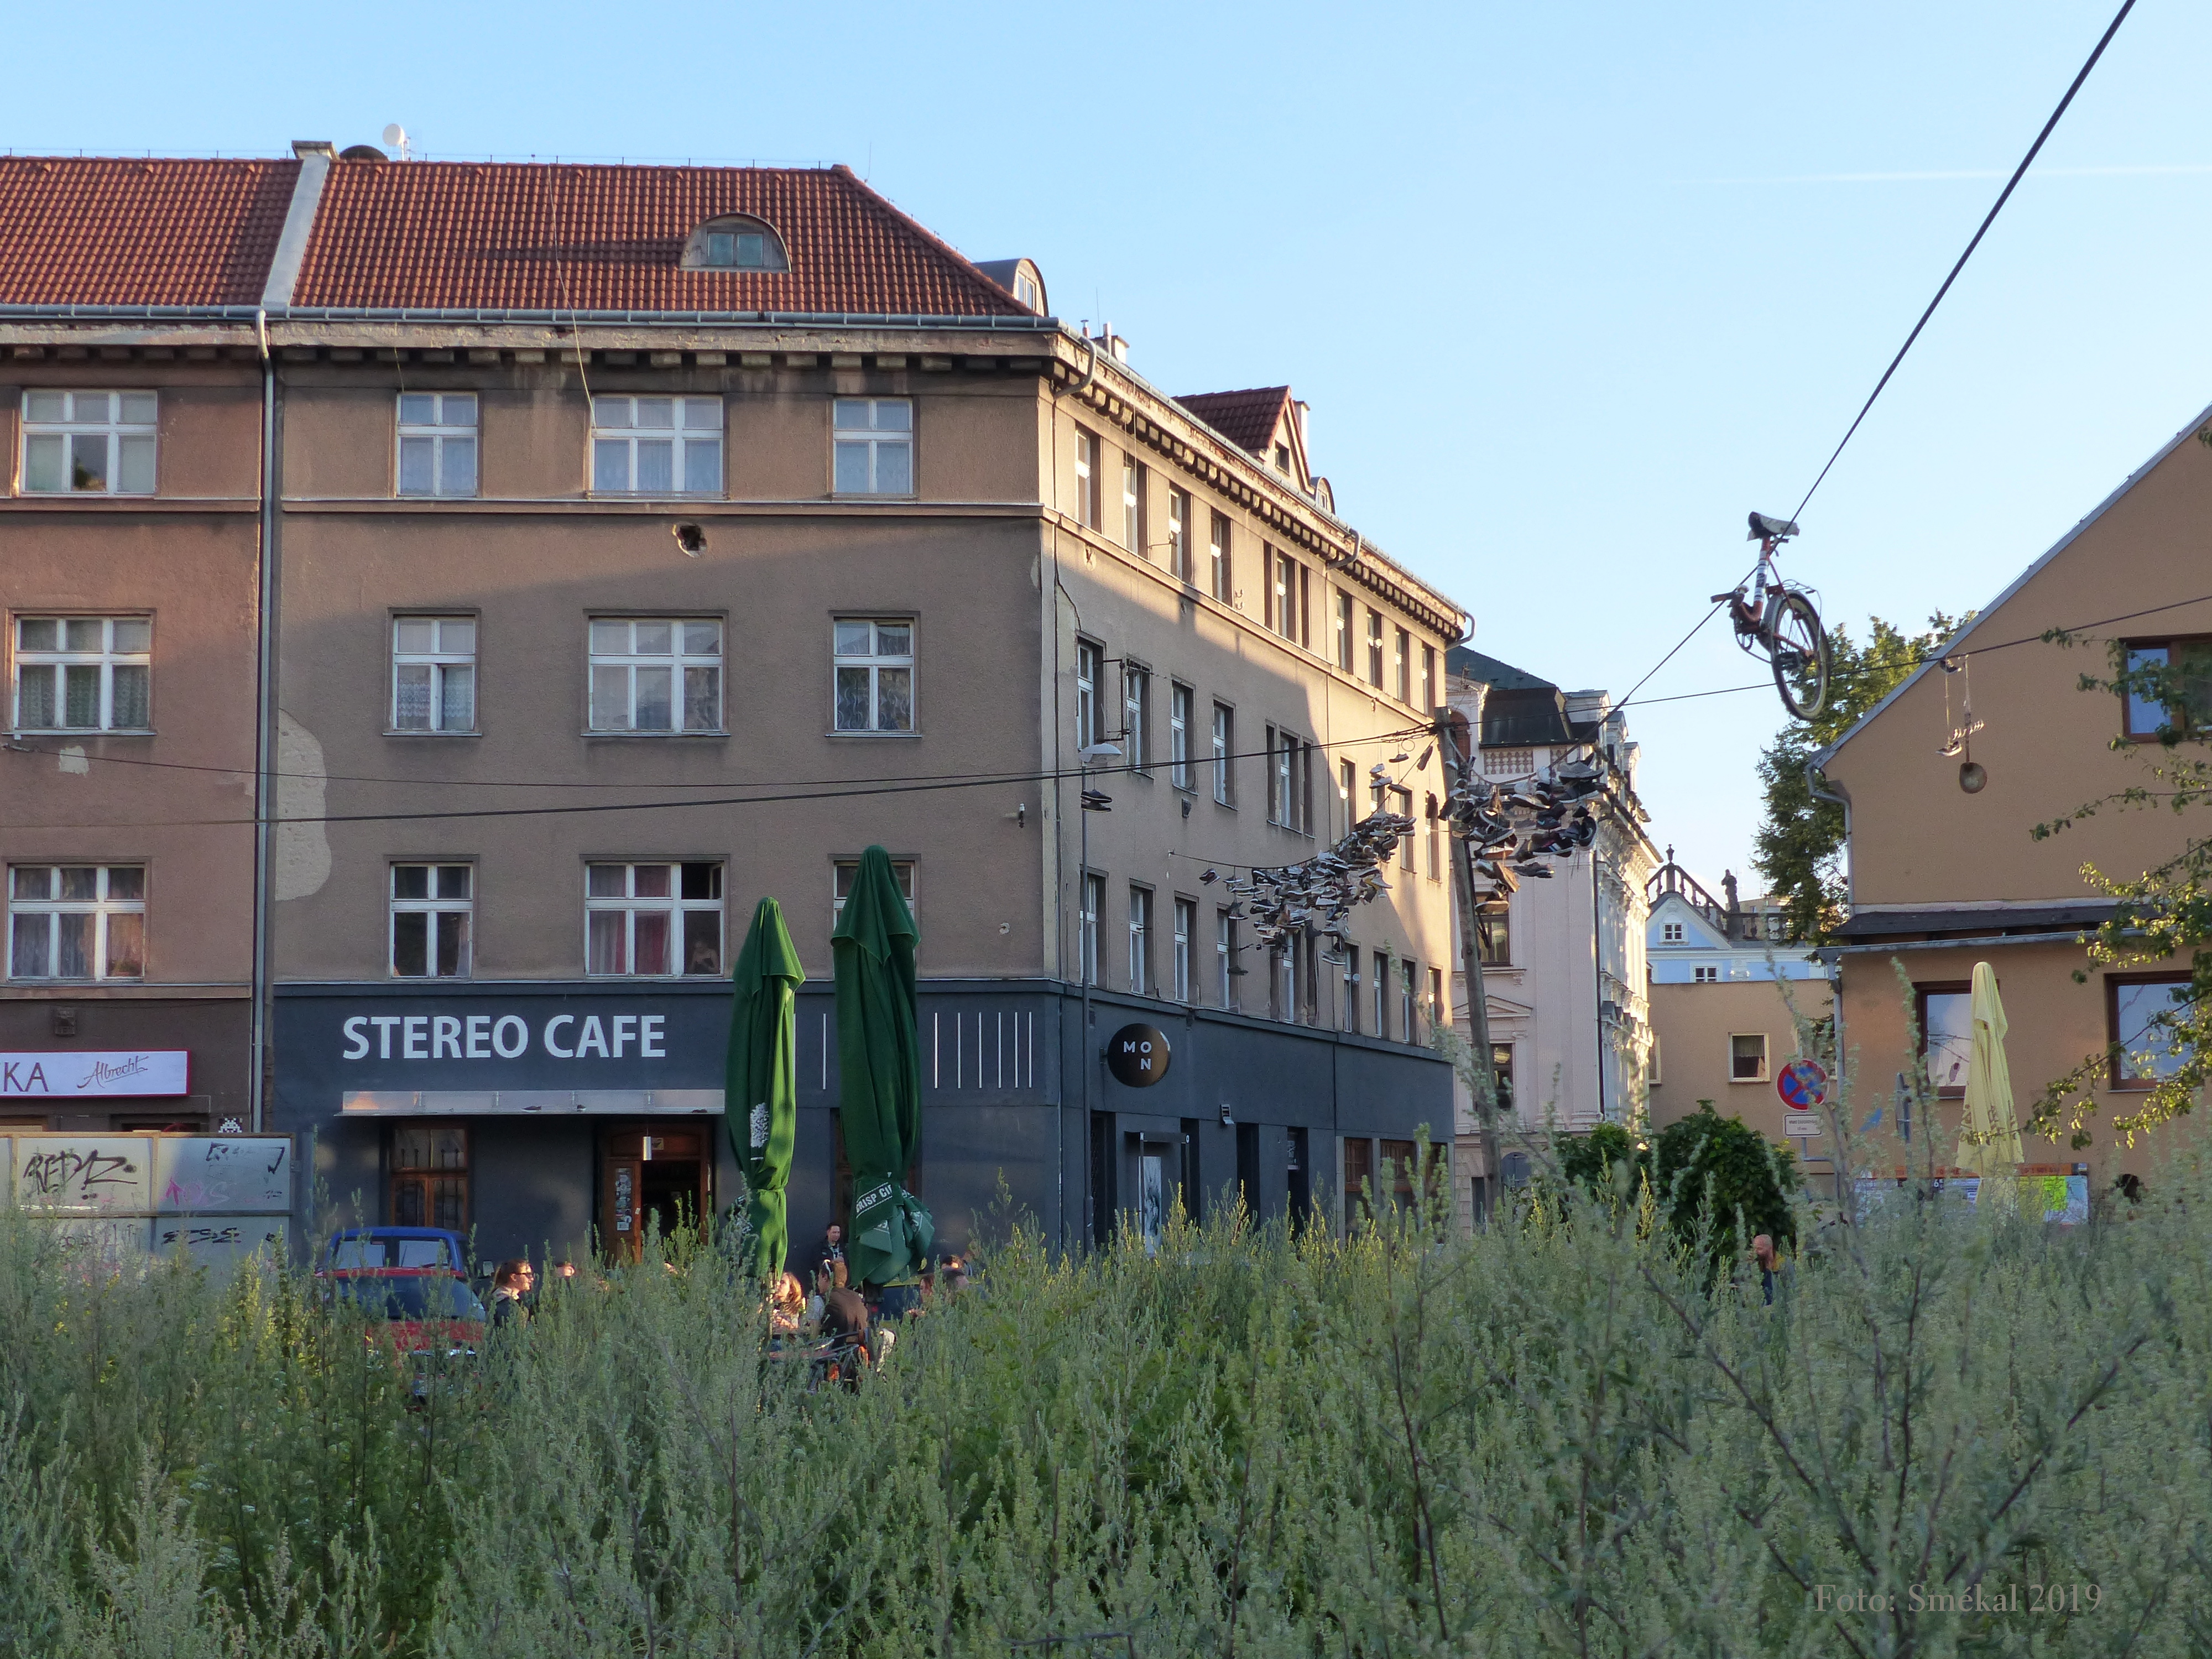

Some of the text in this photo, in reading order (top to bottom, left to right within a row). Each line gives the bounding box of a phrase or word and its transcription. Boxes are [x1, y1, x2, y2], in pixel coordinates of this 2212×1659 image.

[343, 1014, 665, 1060] STEREO CAFE
[0, 1055, 149, 1092] KA Albrecht
[855, 1193, 877, 1213] CRISP
